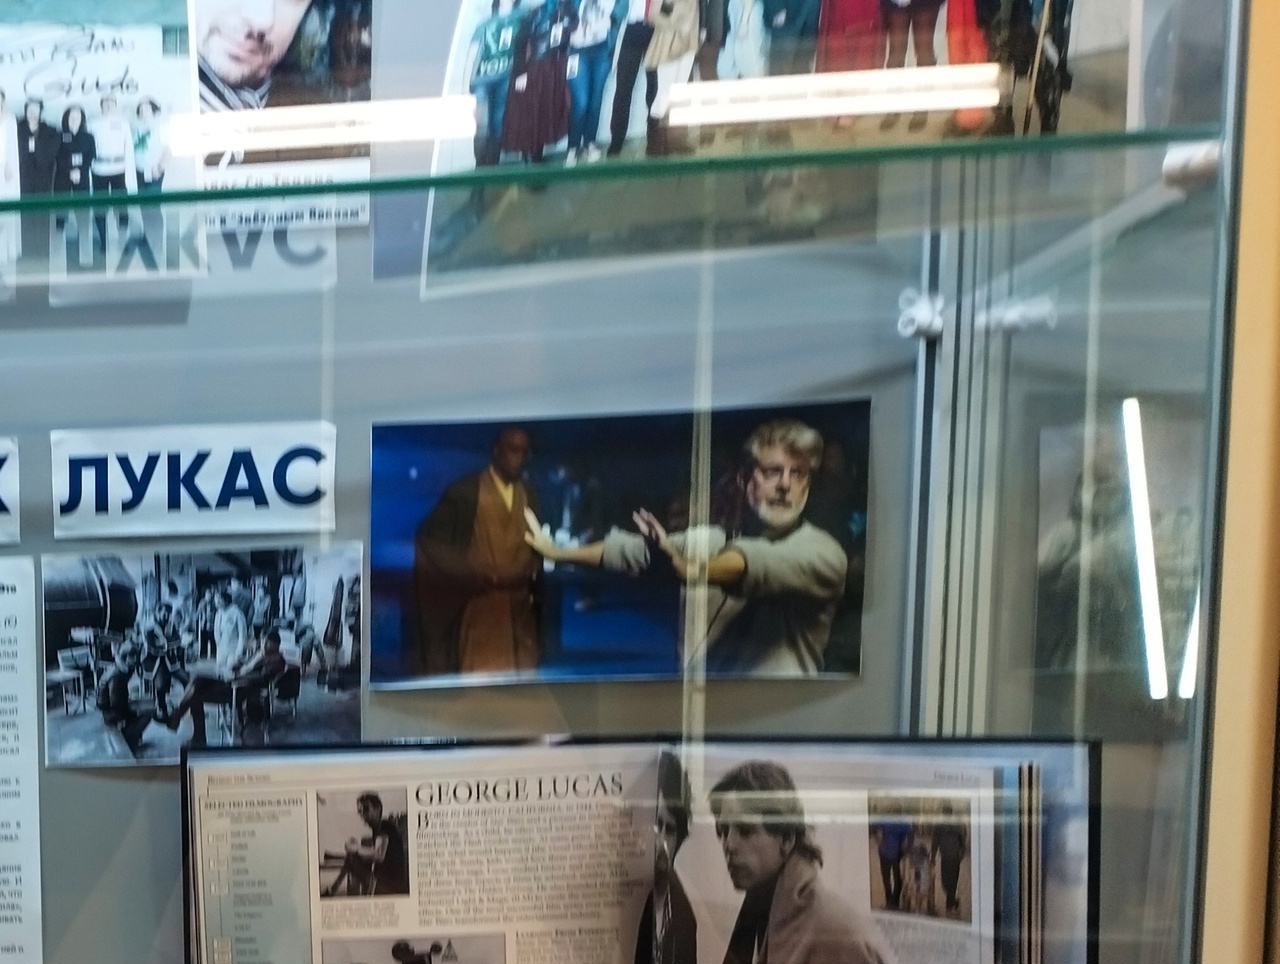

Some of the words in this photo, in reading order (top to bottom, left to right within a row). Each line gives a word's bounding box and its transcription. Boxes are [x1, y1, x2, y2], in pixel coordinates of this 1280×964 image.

[60, 446, 328, 516] ЛУКАС
[415, 777, 528, 807] GEORGE
[538, 772, 623, 800] LUCAS
